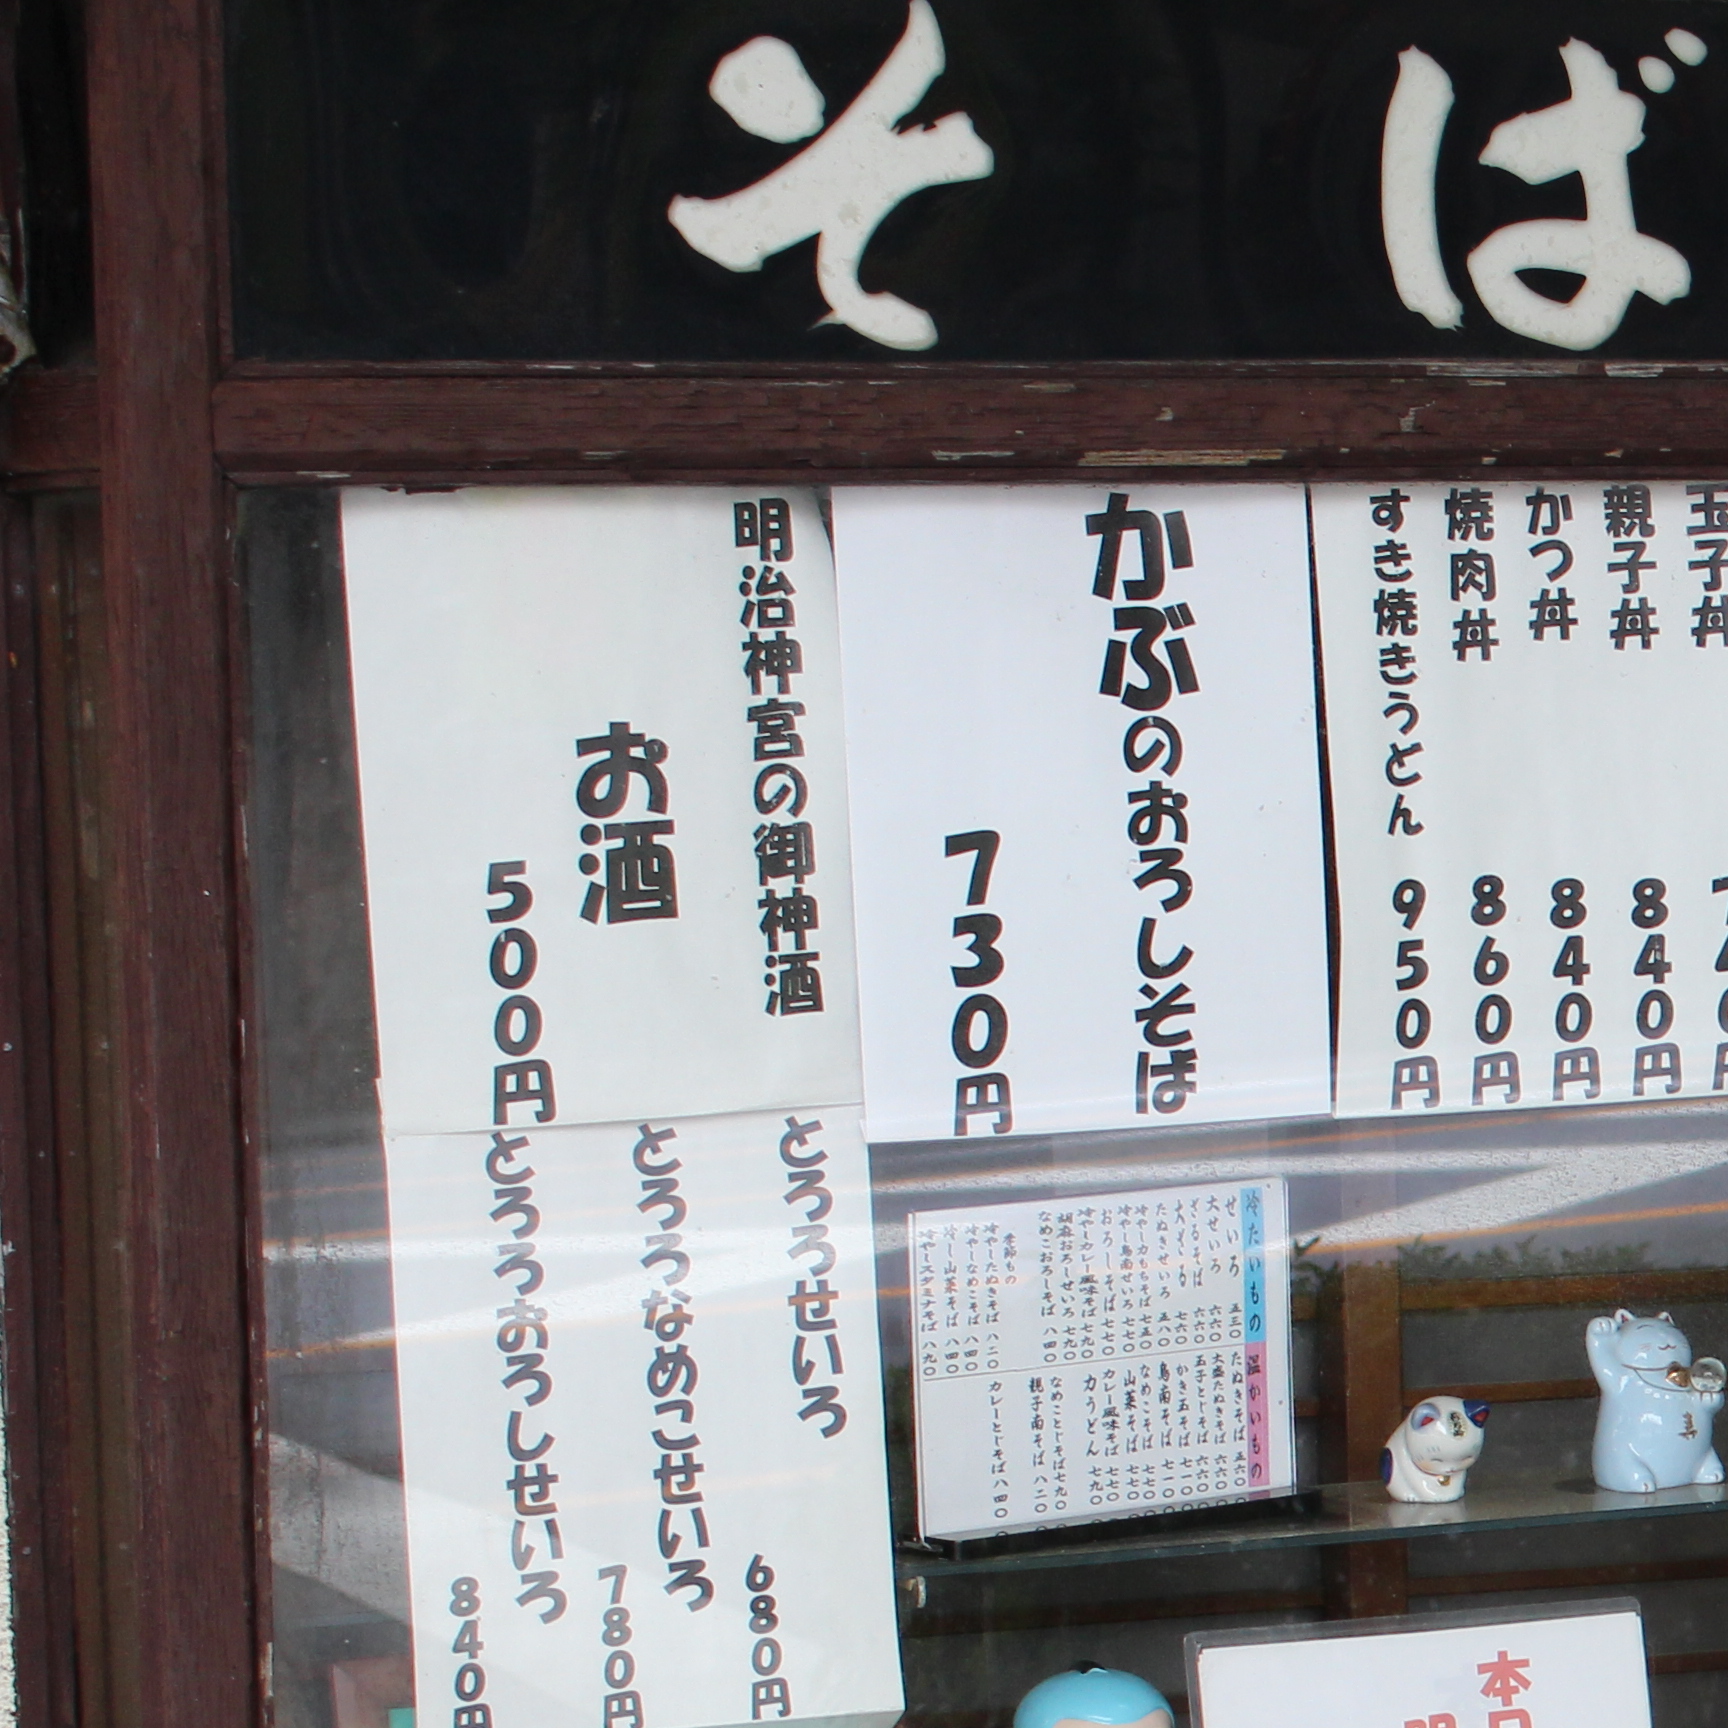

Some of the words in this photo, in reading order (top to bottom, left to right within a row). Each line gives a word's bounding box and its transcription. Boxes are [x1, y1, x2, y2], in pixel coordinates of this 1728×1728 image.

[1369, 489, 1425, 837] すき焼きうどん
[1445, 487, 1500, 662] 焼肉丼
[1525, 489, 1579, 641] かつ丼
[1603, 485, 1660, 650] 親子丼
[574, 720, 681, 926] お酒
[733, 497, 825, 1018] 明治神宮の御神酒
[1084, 492, 1200, 1116] かぶのおろしそば
[484, 860, 558, 1126] 500円
[943, 829, 1014, 1137] 730円
[1389, 878, 1441, 1111] 950円
[1470, 874, 1521, 1106] 860円
[1548, 877, 1601, 1101] 840円
[1630, 877, 1683, 1097] 840円
[778, 1115, 848, 1440] とろろせいろ
[1101, 1208, 1116, 1313] おろしそば
[1206, 1195, 1221, 1275] 大せいろ
[1225, 1195, 1240, 1277] せいろ
[1245, 1190, 1261, 1333] 冷たいもの
[484, 1131, 568, 1625] とろろおろしせいろ
[631, 1123, 714, 1613] とろろなめこせいろ
[1247, 1354, 1262, 1479] 温かいもの
[744, 1553, 792, 1721] 680円
